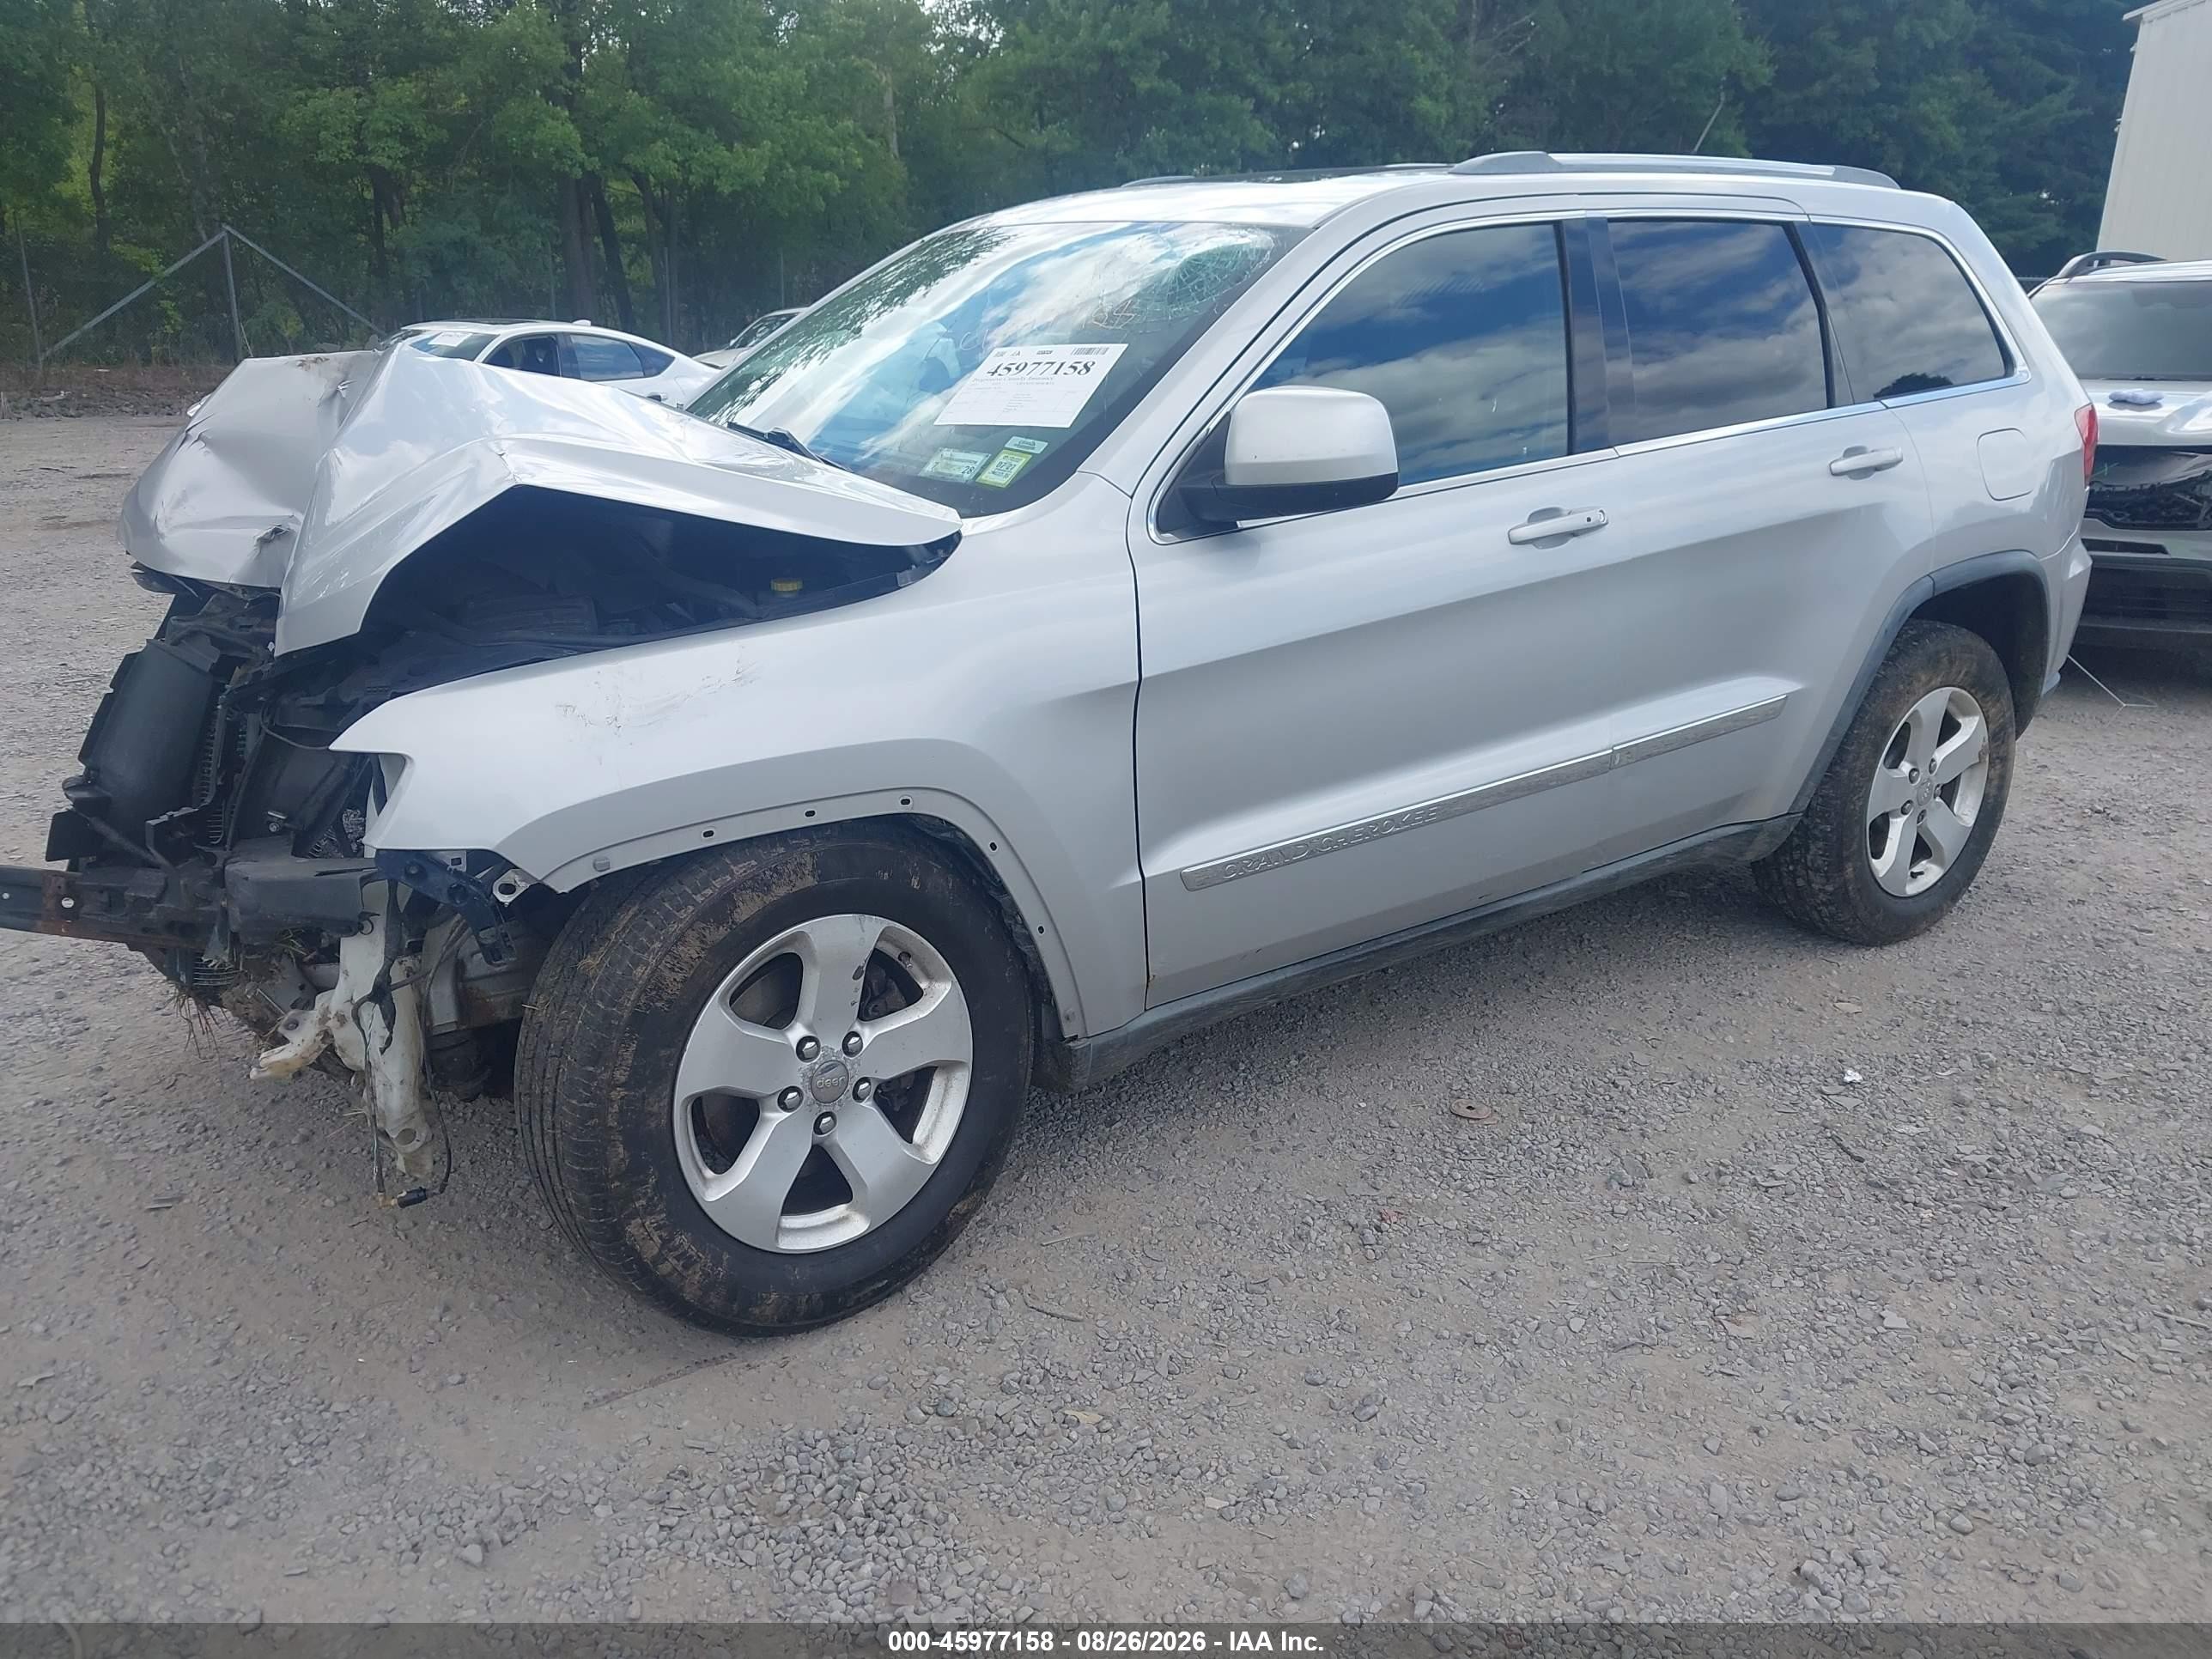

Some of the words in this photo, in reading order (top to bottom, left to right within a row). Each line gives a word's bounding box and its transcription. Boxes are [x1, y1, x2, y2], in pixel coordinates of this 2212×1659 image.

[988, 361, 1096, 376] 45977158
[961, 465, 975, 475] 28
[1223, 842, 1310, 879] GRAND
[1315, 806, 1437, 853] CHEROKEE
[816, 1076, 846, 1089] Jeep
